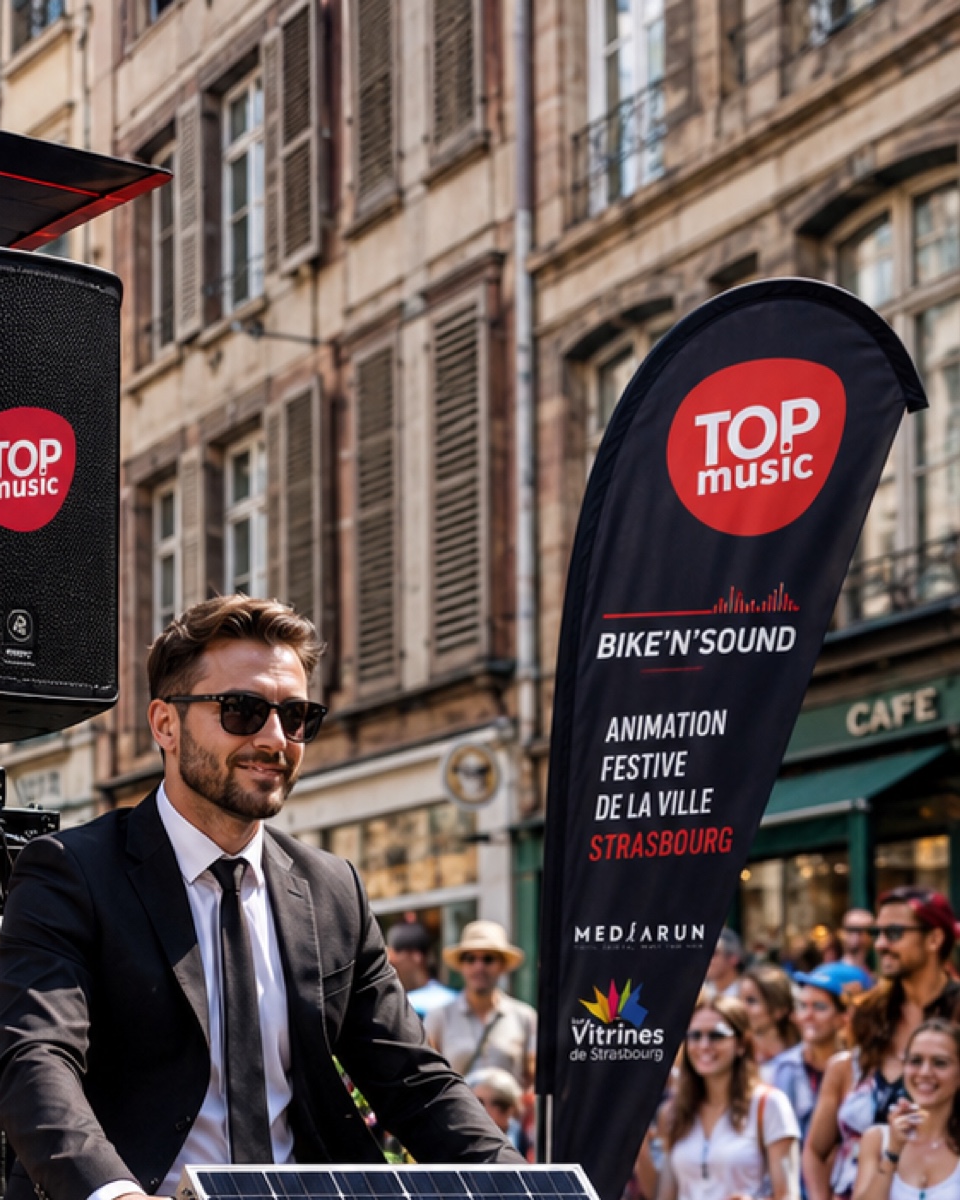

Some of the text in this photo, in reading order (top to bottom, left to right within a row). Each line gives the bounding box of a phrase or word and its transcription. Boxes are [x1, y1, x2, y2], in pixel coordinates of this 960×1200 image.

[695, 397, 820, 466] TOP
[697, 453, 813, 496] music
[596, 626, 797, 660] BIKE'N'SOUND
[604, 709, 728, 743] ANIMATION
[846, 687, 937, 736] CAFE
[600, 750, 688, 782] FESTIVE
[595, 788, 714, 821] DE LA VILLE
[589, 826, 733, 862] STRASBOURG
[571, 1018, 664, 1045] Vitrines
[569, 1047, 664, 1062] de Strasbourg
